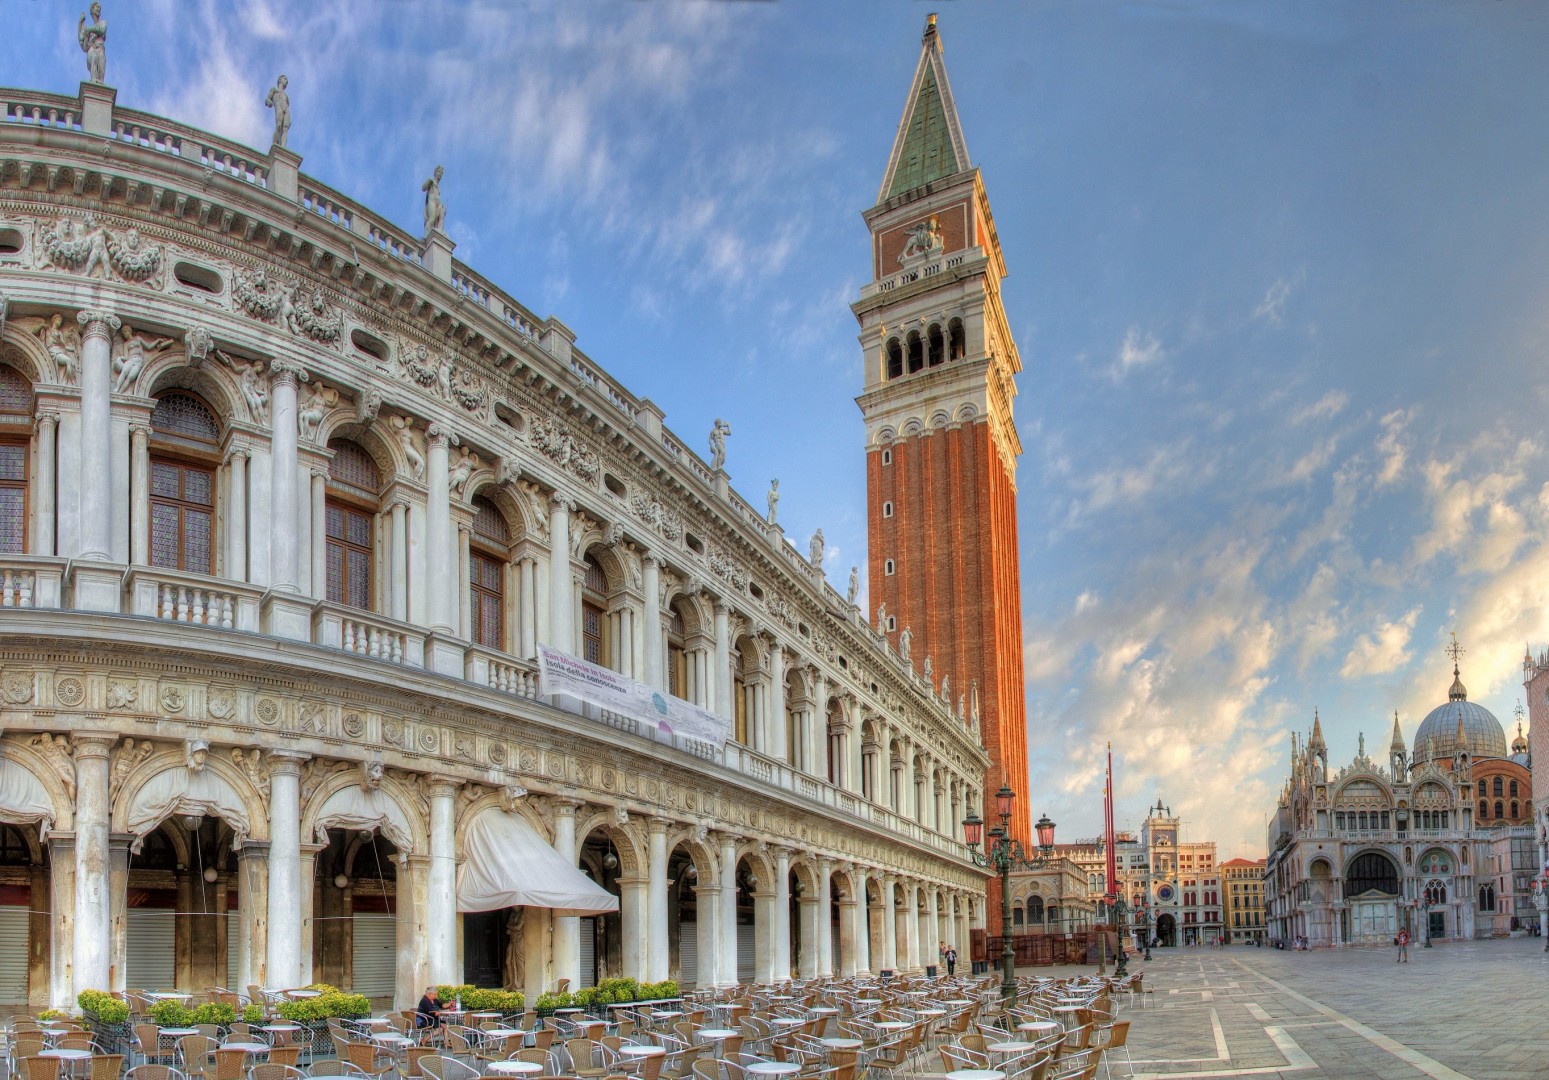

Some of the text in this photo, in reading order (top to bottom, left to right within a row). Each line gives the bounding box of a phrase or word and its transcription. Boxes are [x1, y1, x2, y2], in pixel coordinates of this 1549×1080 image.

[543, 650, 559, 661] San
[560, 656, 589, 673] Michele
[590, 667, 599, 676] in
[546, 658, 565, 671] Isola
[567, 667, 585, 678] della
[586, 674, 627, 693] conoscenza
